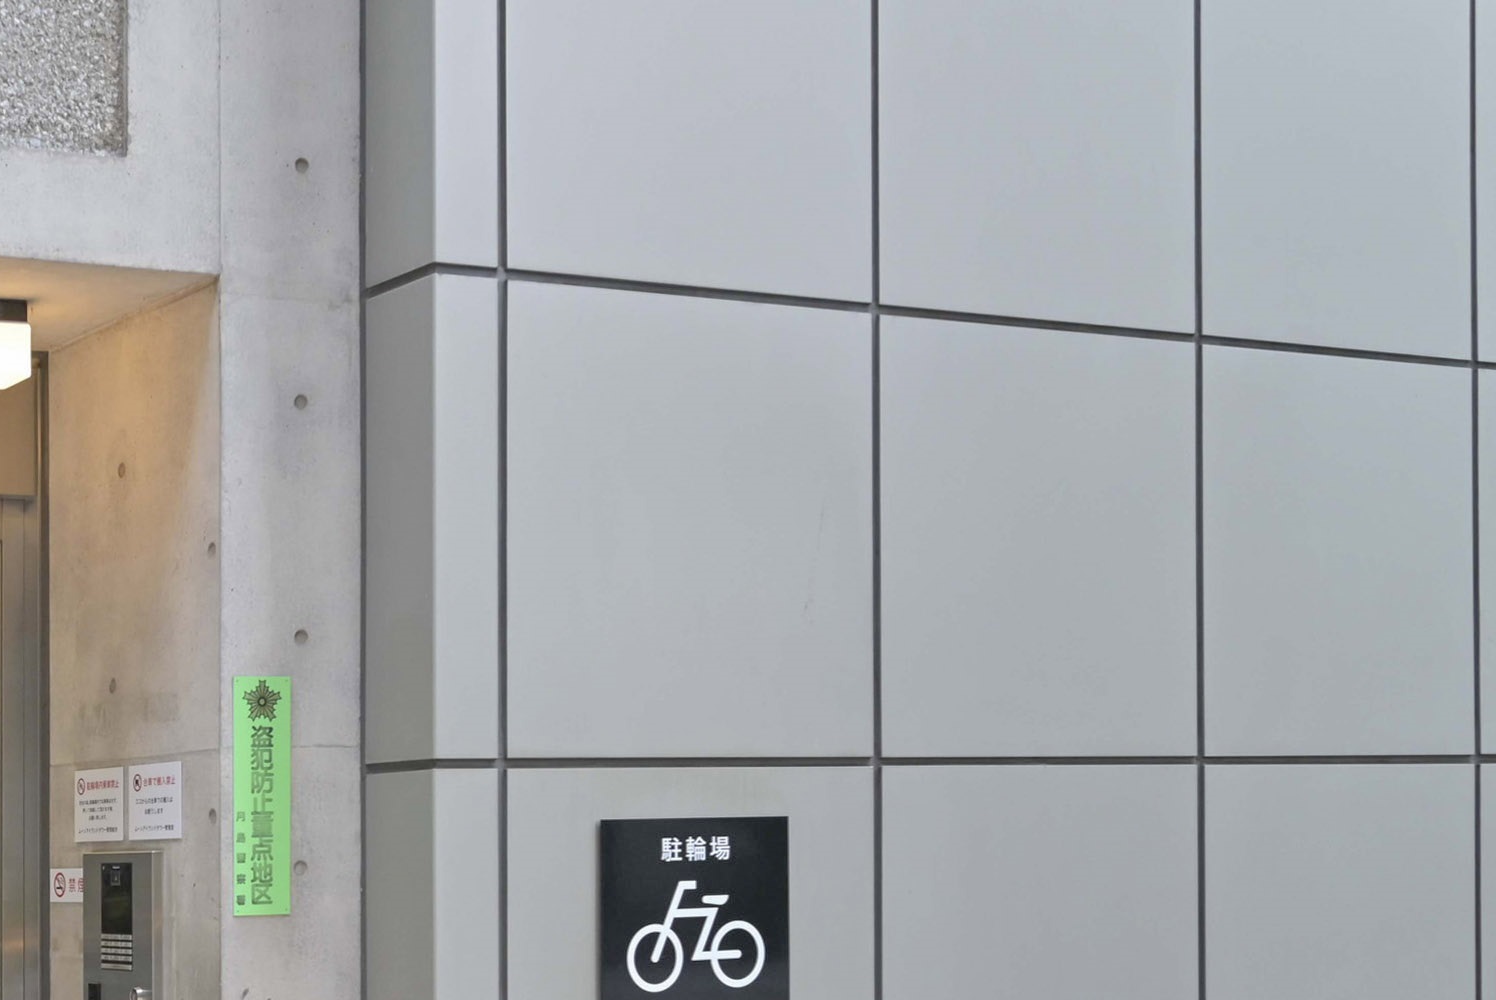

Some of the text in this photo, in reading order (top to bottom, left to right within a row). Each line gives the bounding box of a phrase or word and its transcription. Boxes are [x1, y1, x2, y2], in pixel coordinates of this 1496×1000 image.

[250, 725, 274, 905] 盗犯防止重点地区
[660, 836, 731, 862] 駐輪場
